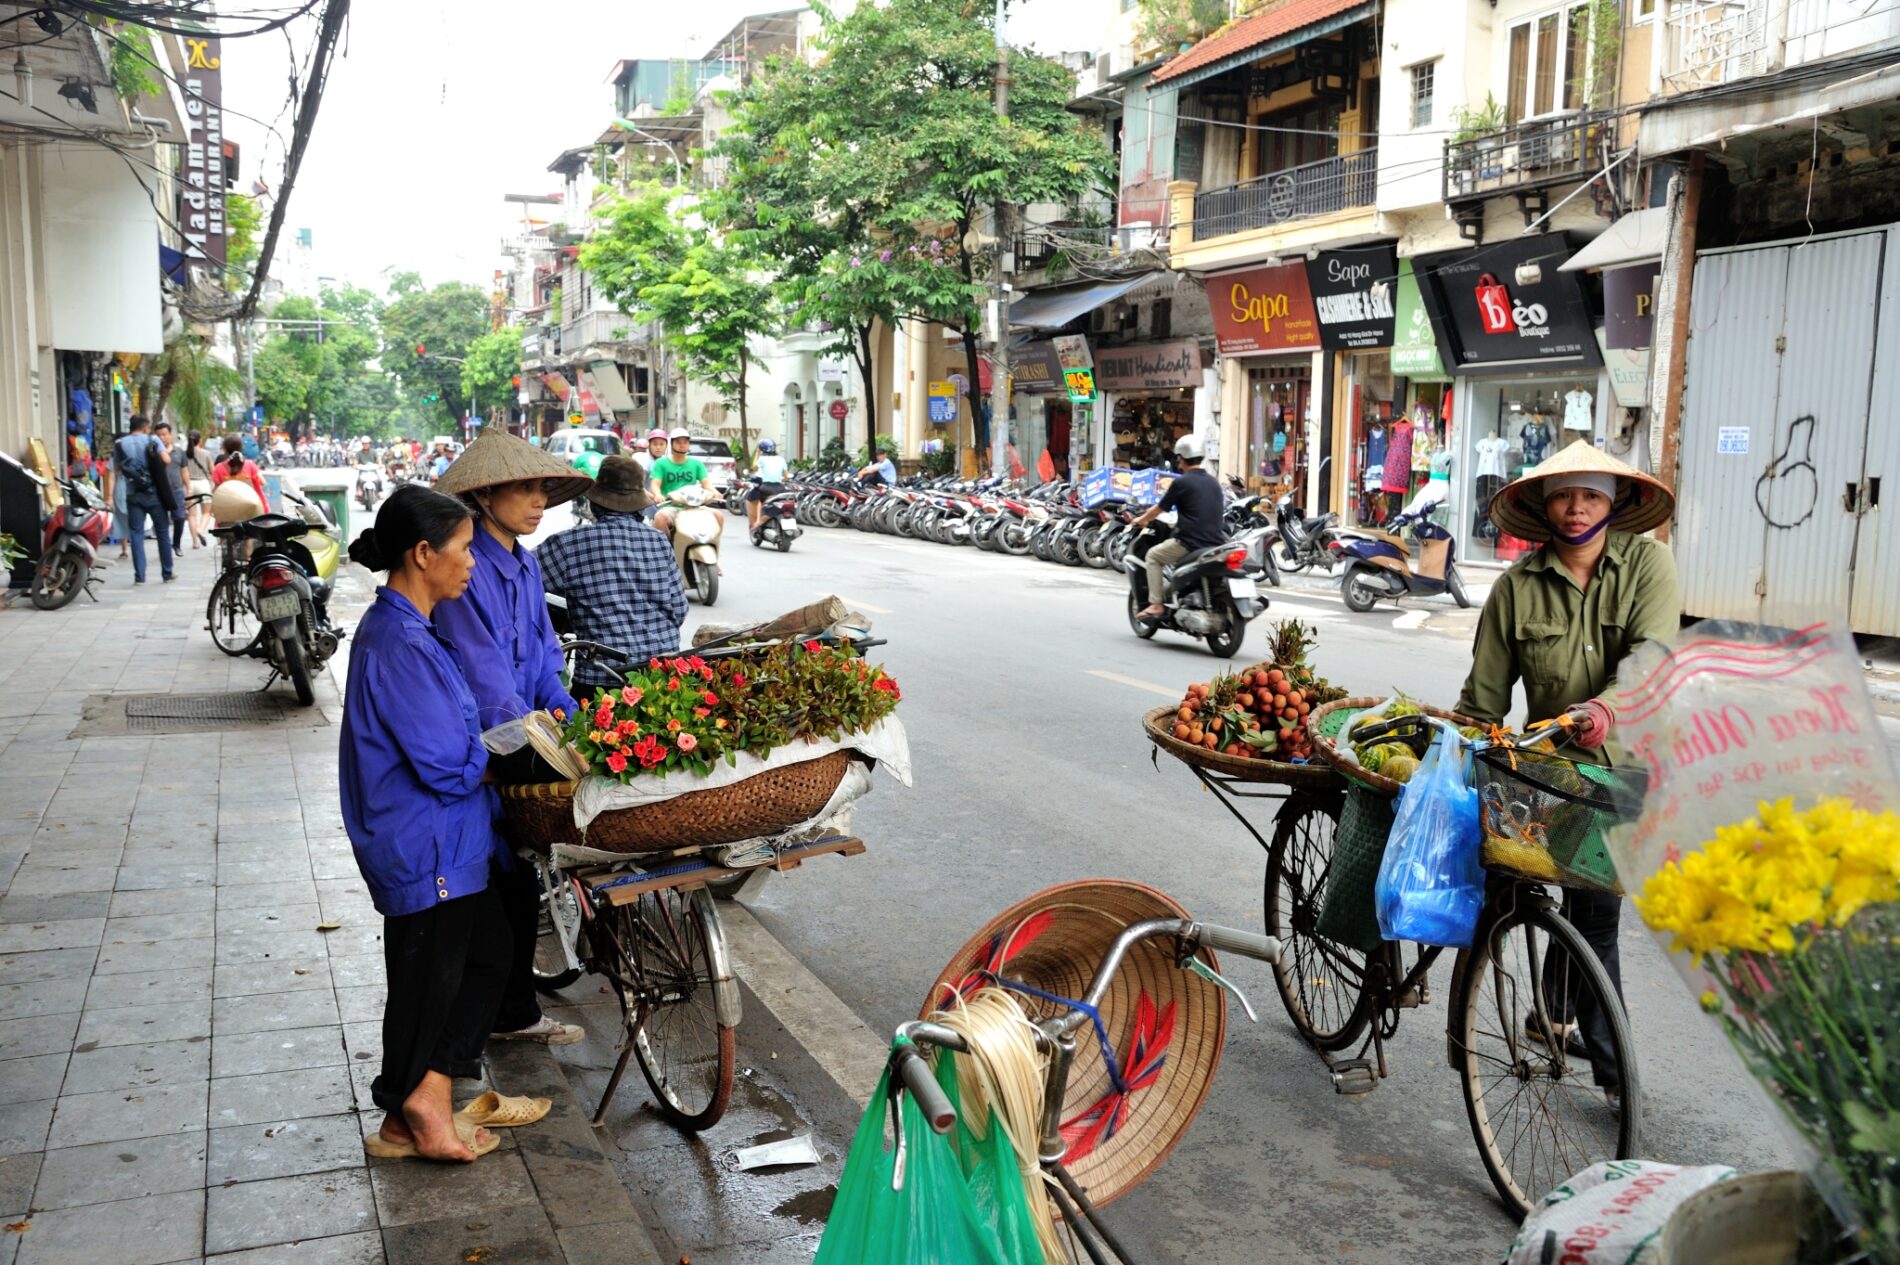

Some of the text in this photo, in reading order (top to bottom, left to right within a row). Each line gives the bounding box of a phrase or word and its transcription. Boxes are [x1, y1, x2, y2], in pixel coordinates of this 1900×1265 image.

[207, 106, 223, 234] RESTAURANT
[184, 143, 207, 259] Madam
[1327, 258, 1371, 287] Sapa
[1231, 283, 1290, 333] Sapa
[1316, 291, 1364, 324] CASHMERE
[1362, 290, 1374, 320] &
[1482, 290, 1548, 329] bèo
[1635, 294, 1653, 316] P
[1518, 325, 1550, 338] Boutique
[1135, 349, 1192, 378] Handicraft
[667, 471, 693, 484] DHS
